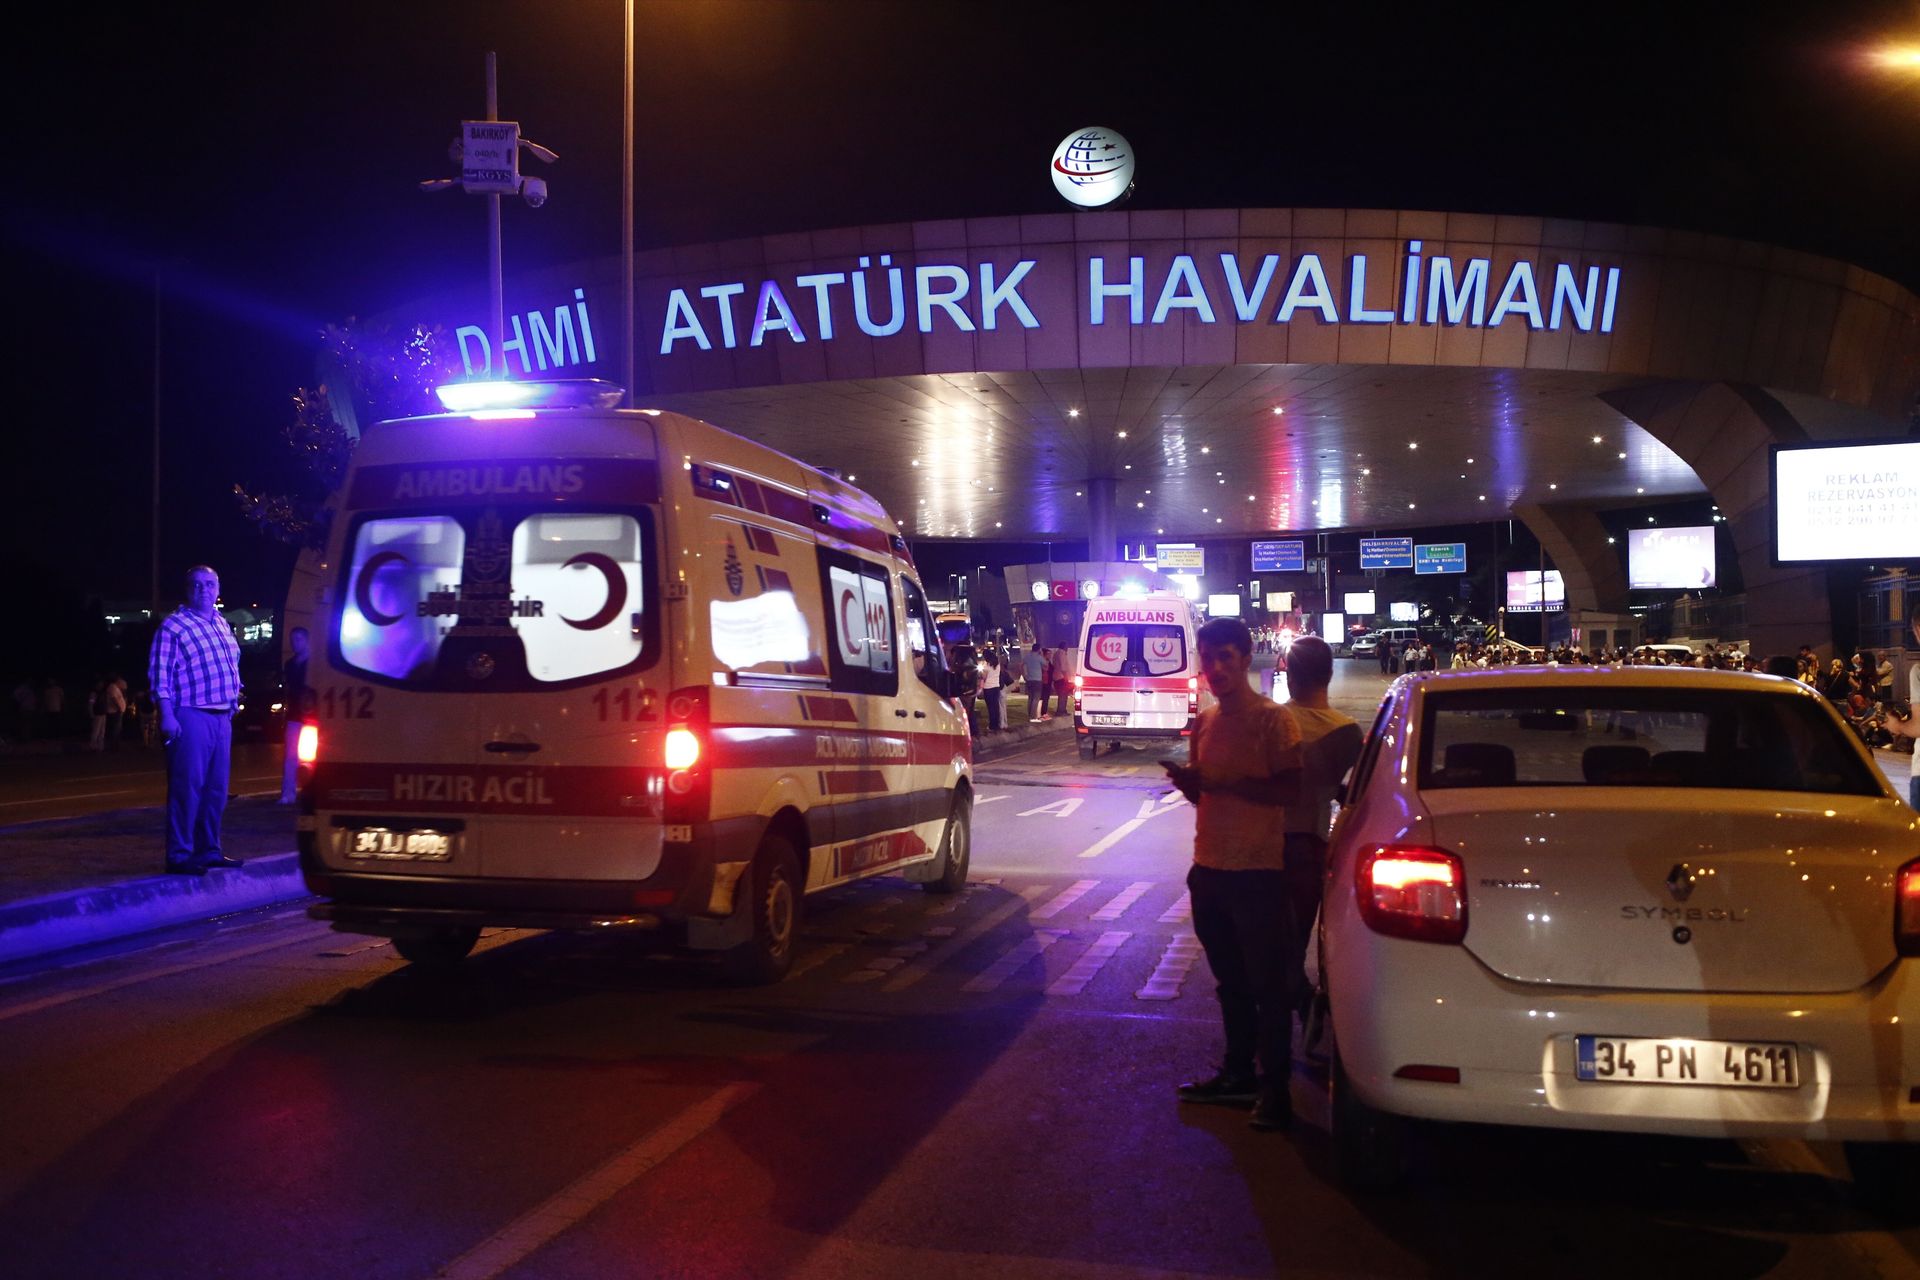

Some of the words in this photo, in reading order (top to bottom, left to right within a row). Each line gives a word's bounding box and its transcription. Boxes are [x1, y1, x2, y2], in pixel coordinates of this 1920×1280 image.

[455, 288, 596, 378] DHMİ
[660, 254, 1040, 354] ATATÜRK
[1090, 240, 1620, 333] HAVALİMANI
[393, 465, 585, 500] AMBULANS
[1808, 487, 1918, 502] REZERVASYON
[1826, 472, 1898, 486] REKLAM
[867, 602, 888, 652] 112
[1096, 612, 1174, 622] AMBULANS
[1103, 642, 1122, 653] 112
[324, 686, 375, 718] 112
[592, 688, 658, 721] 112
[393, 773, 475, 802] HIZIR
[481, 770, 554, 805] ACİL
[1621, 906, 1744, 922] SYMBOL
[1581, 1061, 1595, 1072] TR
[1598, 1042, 1636, 1077] 34
[1656, 1045, 1697, 1079] PN
[1725, 1046, 1793, 1084] 4611
